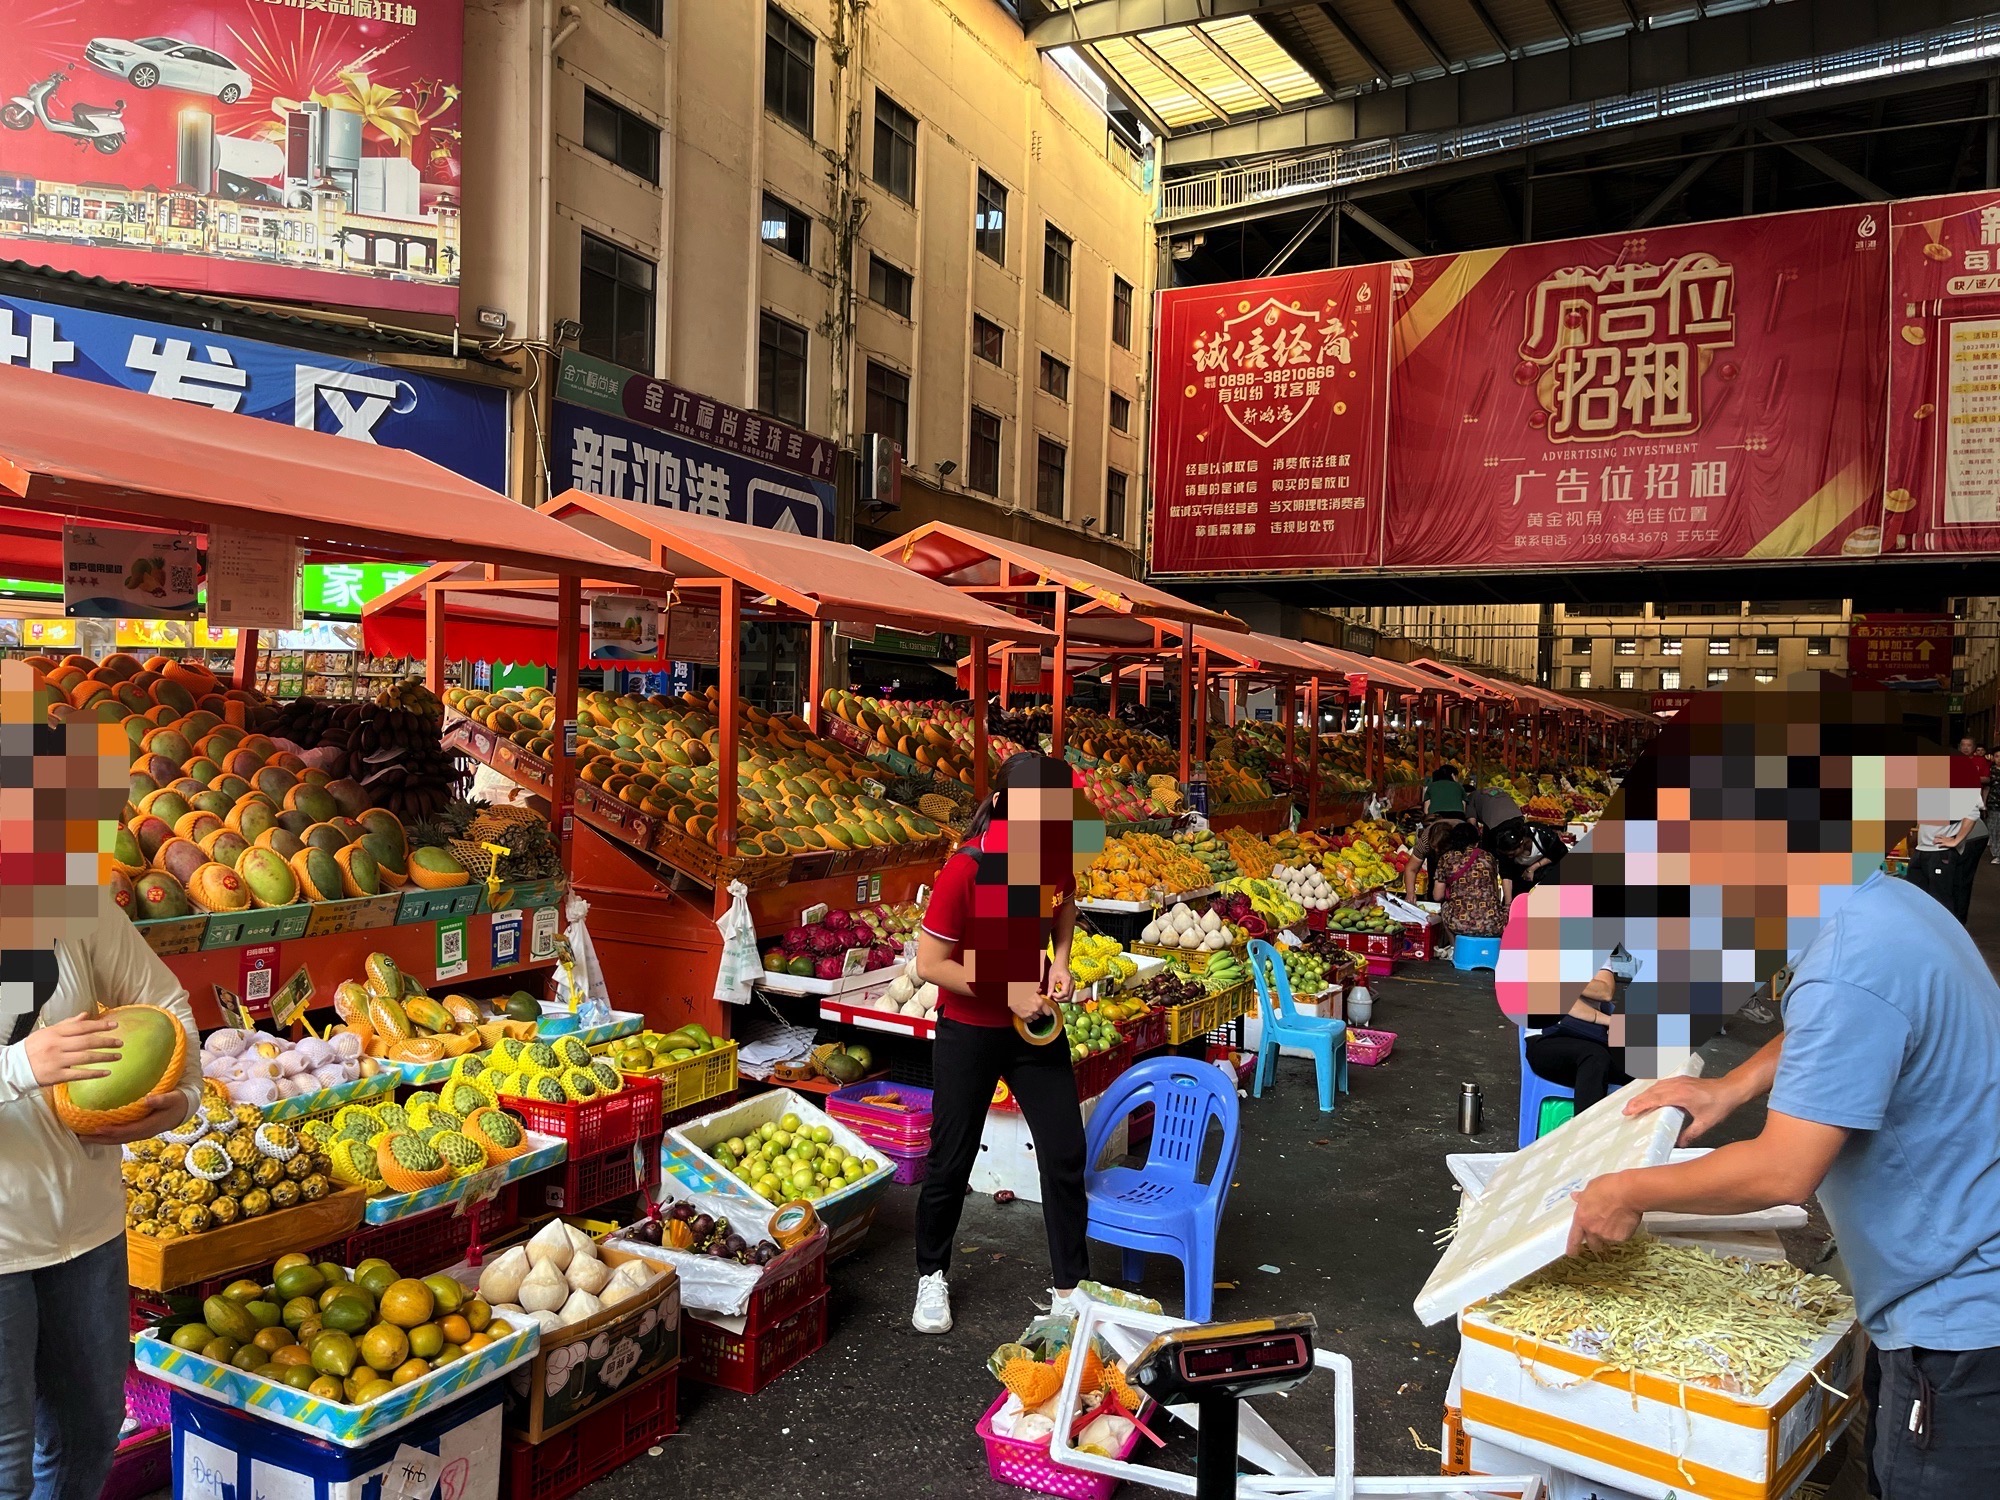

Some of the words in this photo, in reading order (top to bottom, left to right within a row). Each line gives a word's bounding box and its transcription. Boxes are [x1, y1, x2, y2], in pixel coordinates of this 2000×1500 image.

[1524, 252, 1734, 349] 广告位
[1192, 317, 1351, 373] 诚信经商
[1955, 352, 2000, 361] 二、抽奖条
[564, 364, 619, 396] 金六福尚美
[1218, 365, 1335, 388] 0898-38210666
[1555, 342, 1692, 433] 招租
[1218, 385, 1263, 403] 有纠纷
[1273, 380, 1320, 398] 找客服
[644, 383, 803, 459] 金六福尚美珠宝
[1542, 448, 1617, 461] ADVERTISING
[1623, 443, 1698, 456] INVESTMENT
[572, 427, 731, 521] 新鸿港
[1185, 460, 1259, 476] 经营以诚取信
[1272, 454, 1351, 471] 消费依法维权
[1185, 481, 1258, 497] 销售的是诚信
[1272, 476, 1350, 492] 购买的是放心
[1512, 461, 1727, 506] 广告位招租
[1170, 502, 1258, 518] 做诚实守信经营者
[1269, 497, 1365, 513] 当文明理性消费者
[1527, 510, 1602, 527] 黄金视角
[1626, 506, 1708, 524] 绝佳位置
[1195, 523, 1256, 537] 称重需裸称
[1270, 520, 1335, 534] 违规必处罚
[1581, 531, 1668, 545] 13876843678
[1676, 530, 1719, 543] 王先生
[1867, 640, 1914, 650] 海鲜加工
